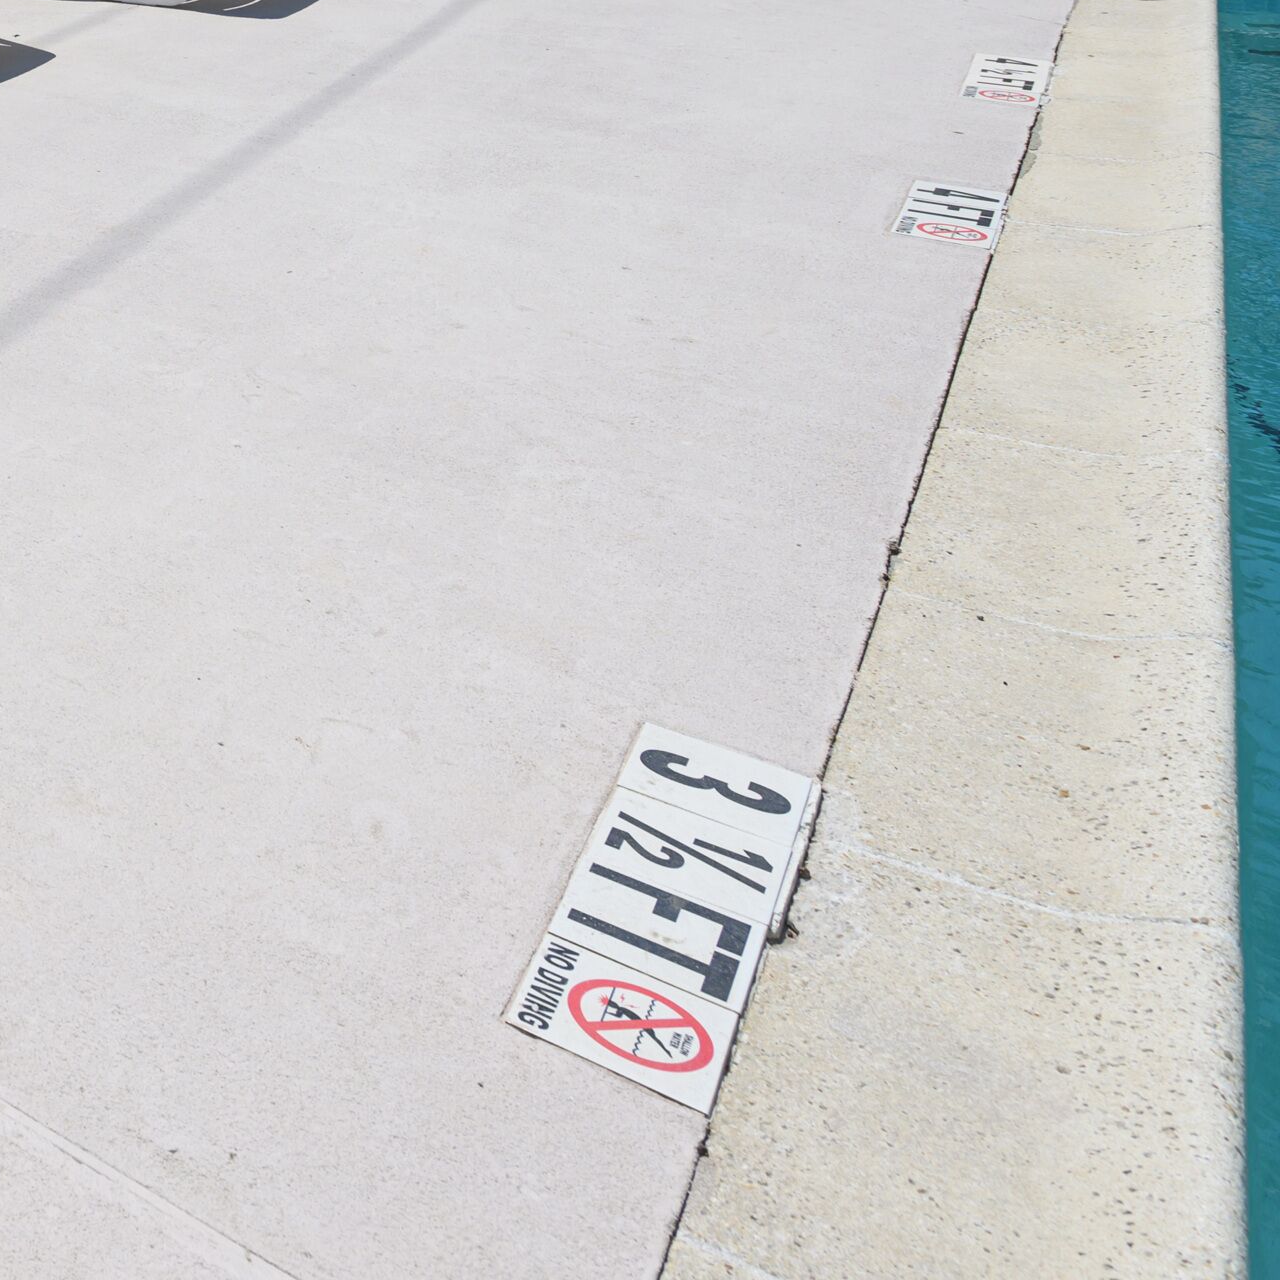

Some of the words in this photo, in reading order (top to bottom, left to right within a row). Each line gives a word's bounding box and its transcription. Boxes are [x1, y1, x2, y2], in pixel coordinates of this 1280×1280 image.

[984, 57, 1038, 66] 4
[977, 75, 1035, 91] FT
[917, 187, 1000, 203] 4
[907, 199, 995, 227] FT
[640, 749, 792, 815] 3
[567, 862, 752, 1003] FT
[544, 941, 580, 971] NO
[518, 967, 569, 1030] DIVING
